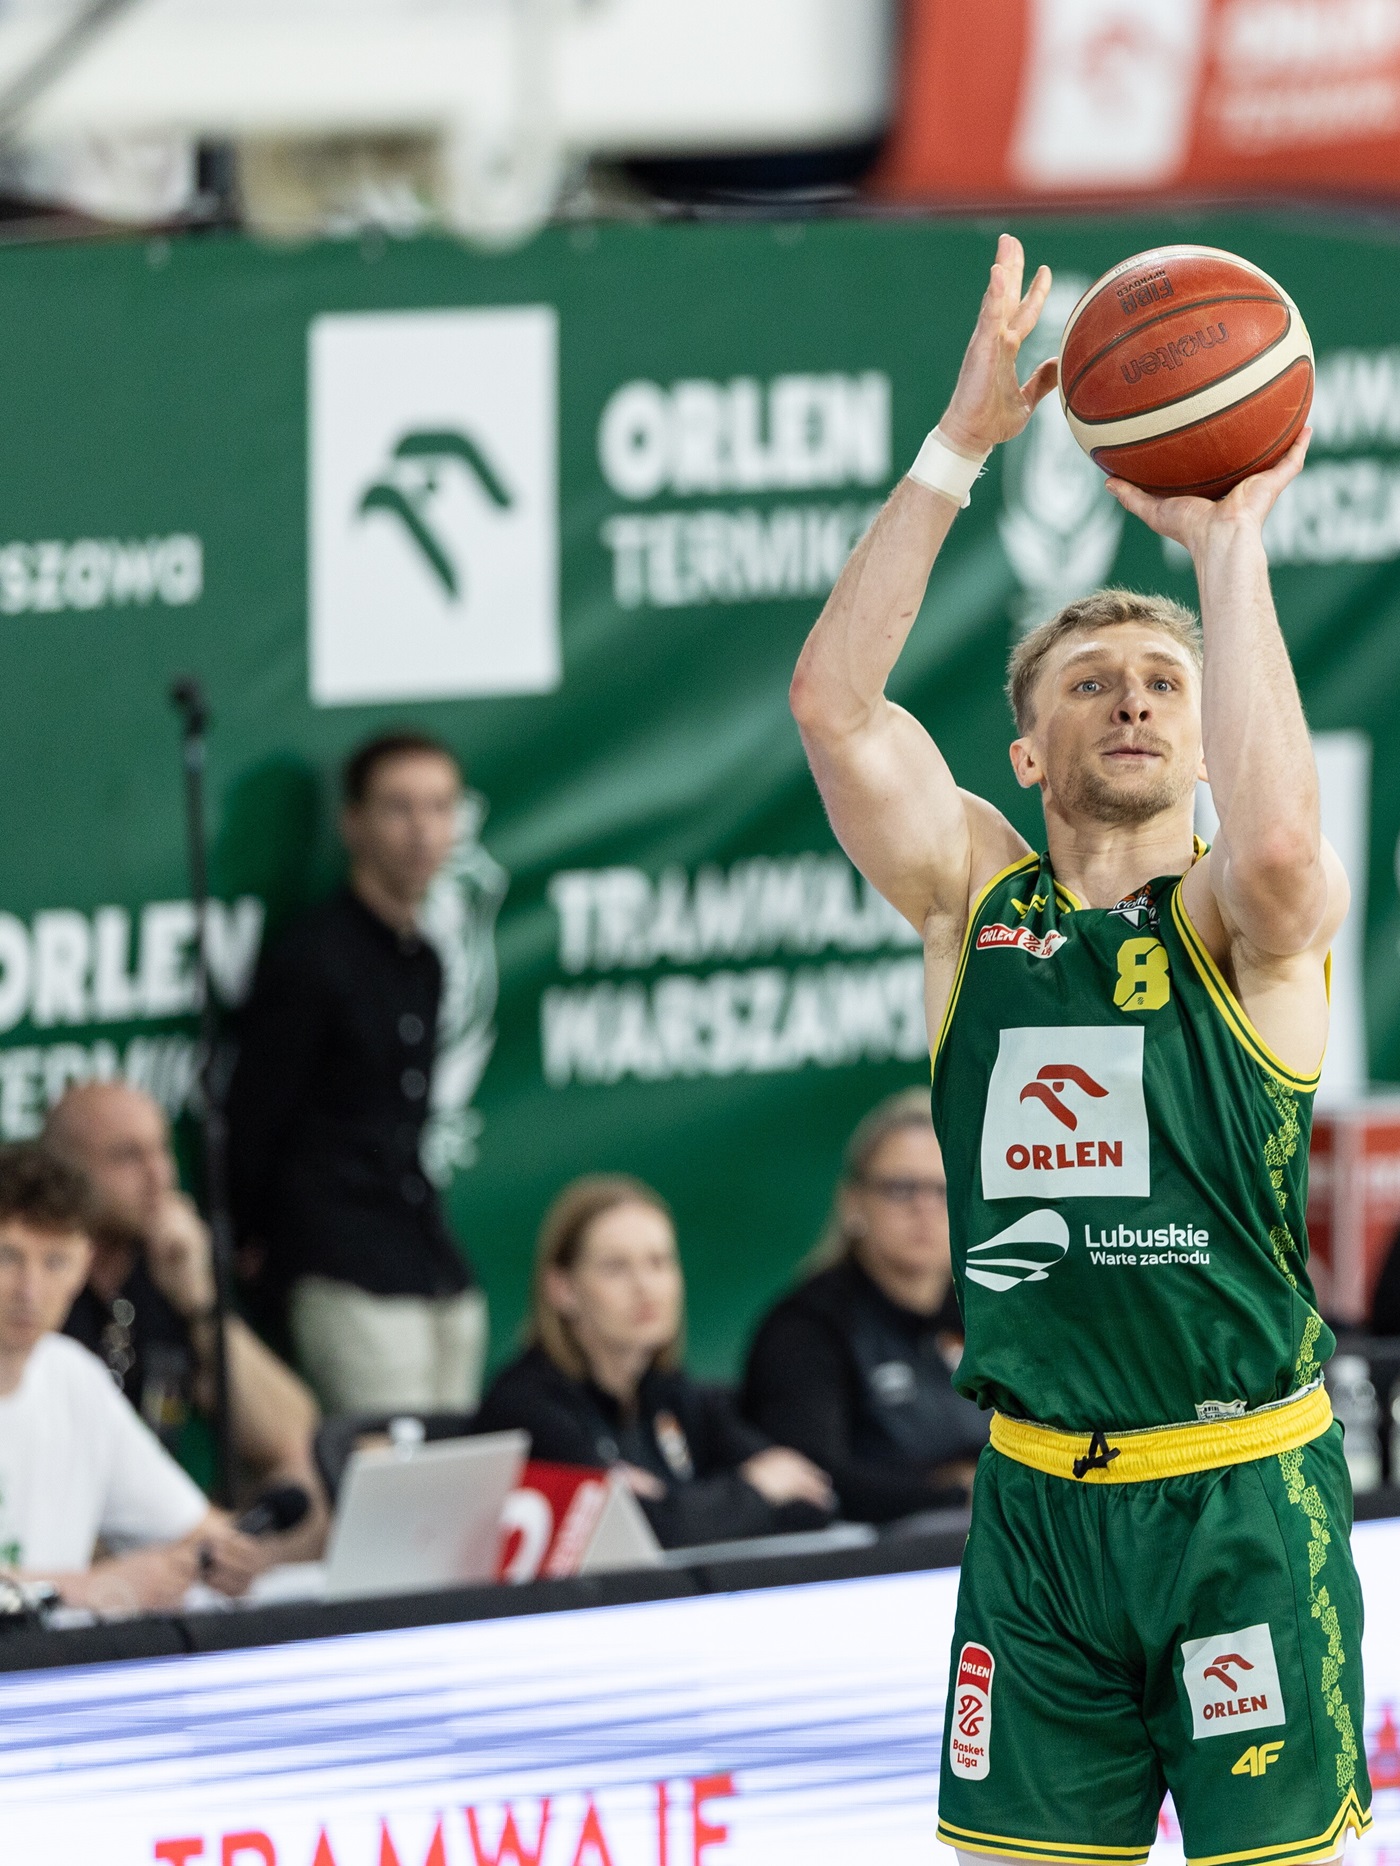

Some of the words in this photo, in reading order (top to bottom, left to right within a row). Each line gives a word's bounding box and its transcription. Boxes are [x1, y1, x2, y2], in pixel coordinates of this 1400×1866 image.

[1116, 269, 1167, 297] APPROVED
[1119, 277, 1175, 316] FIBA
[1120, 322, 1230, 385] molten
[600, 370, 892, 500] ORLEN
[604, 503, 888, 610] TERMIK
[980, 928, 1018, 944] ORLEN
[1113, 937, 1170, 1011] 8
[1006, 1141, 1123, 1170] ORLEN
[1085, 1223, 1209, 1248] Lubuskie
[1090, 1251, 1137, 1265] Warte
[1140, 1250, 1210, 1266] zachodu
[961, 1661, 990, 1679] ORLEN
[1203, 1694, 1268, 1720] ORLEN
[953, 1739, 984, 1756] Basket
[957, 1753, 977, 1768] Liga
[1231, 1740, 1285, 1777] 4F
